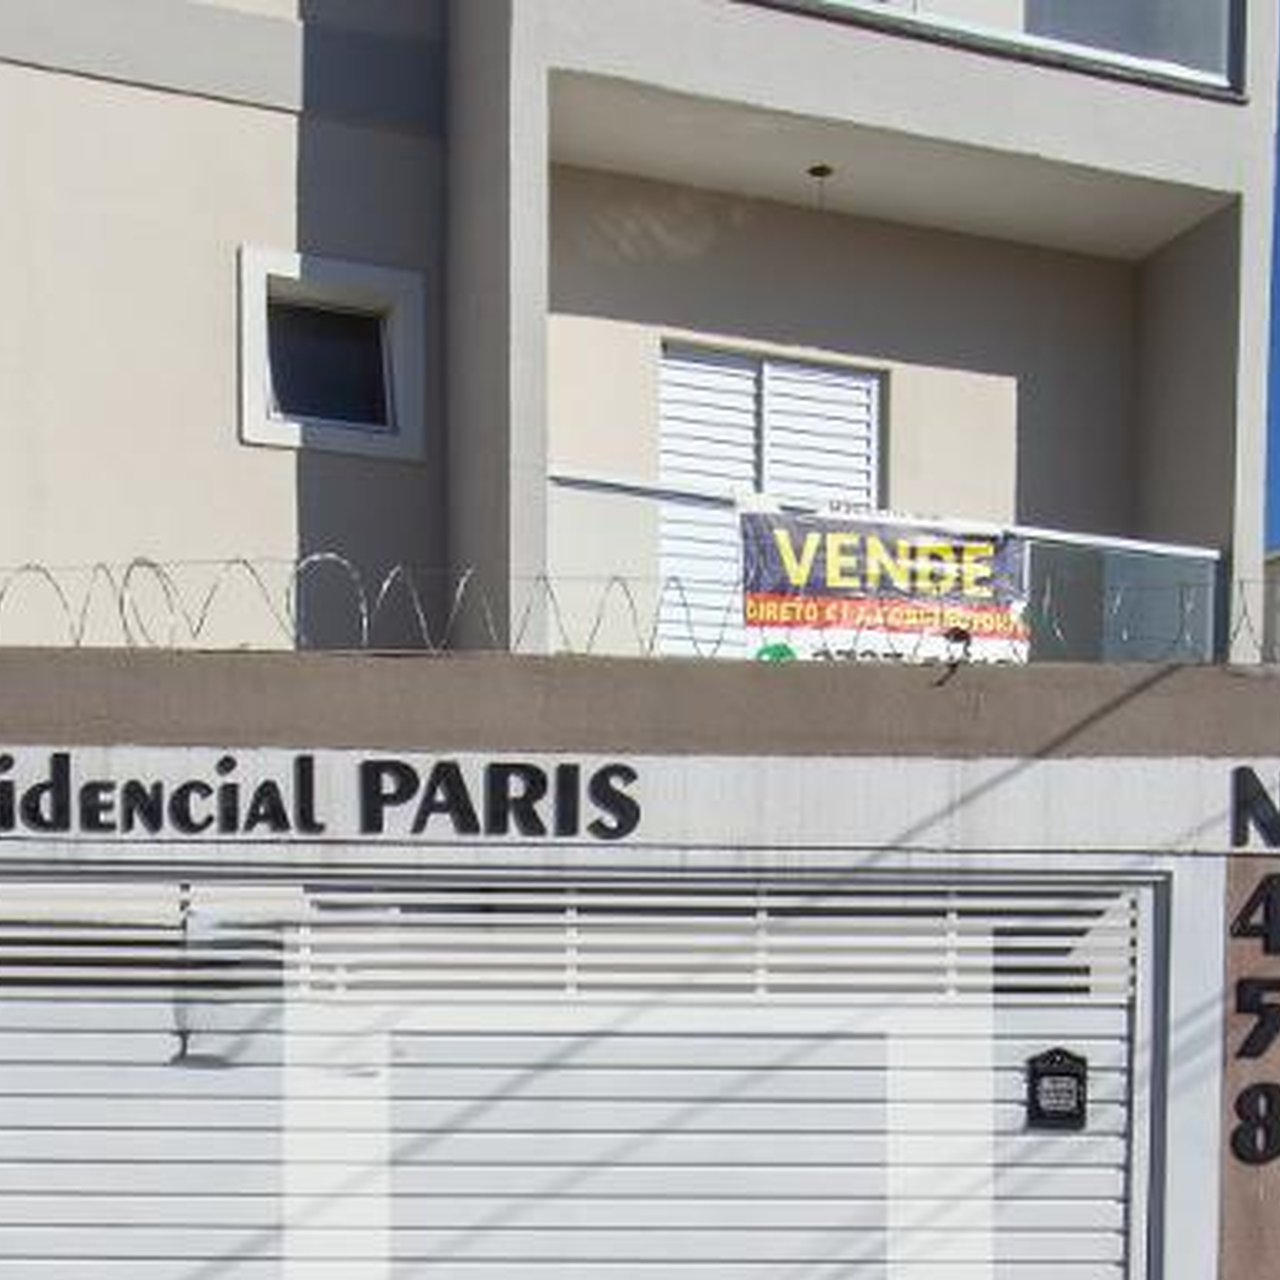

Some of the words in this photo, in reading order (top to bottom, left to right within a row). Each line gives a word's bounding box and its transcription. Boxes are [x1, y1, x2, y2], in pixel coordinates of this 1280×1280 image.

[773, 528, 995, 598] VENDE
[746, 600, 818, 622] DIRETO
[357, 758, 641, 841] PARIS
